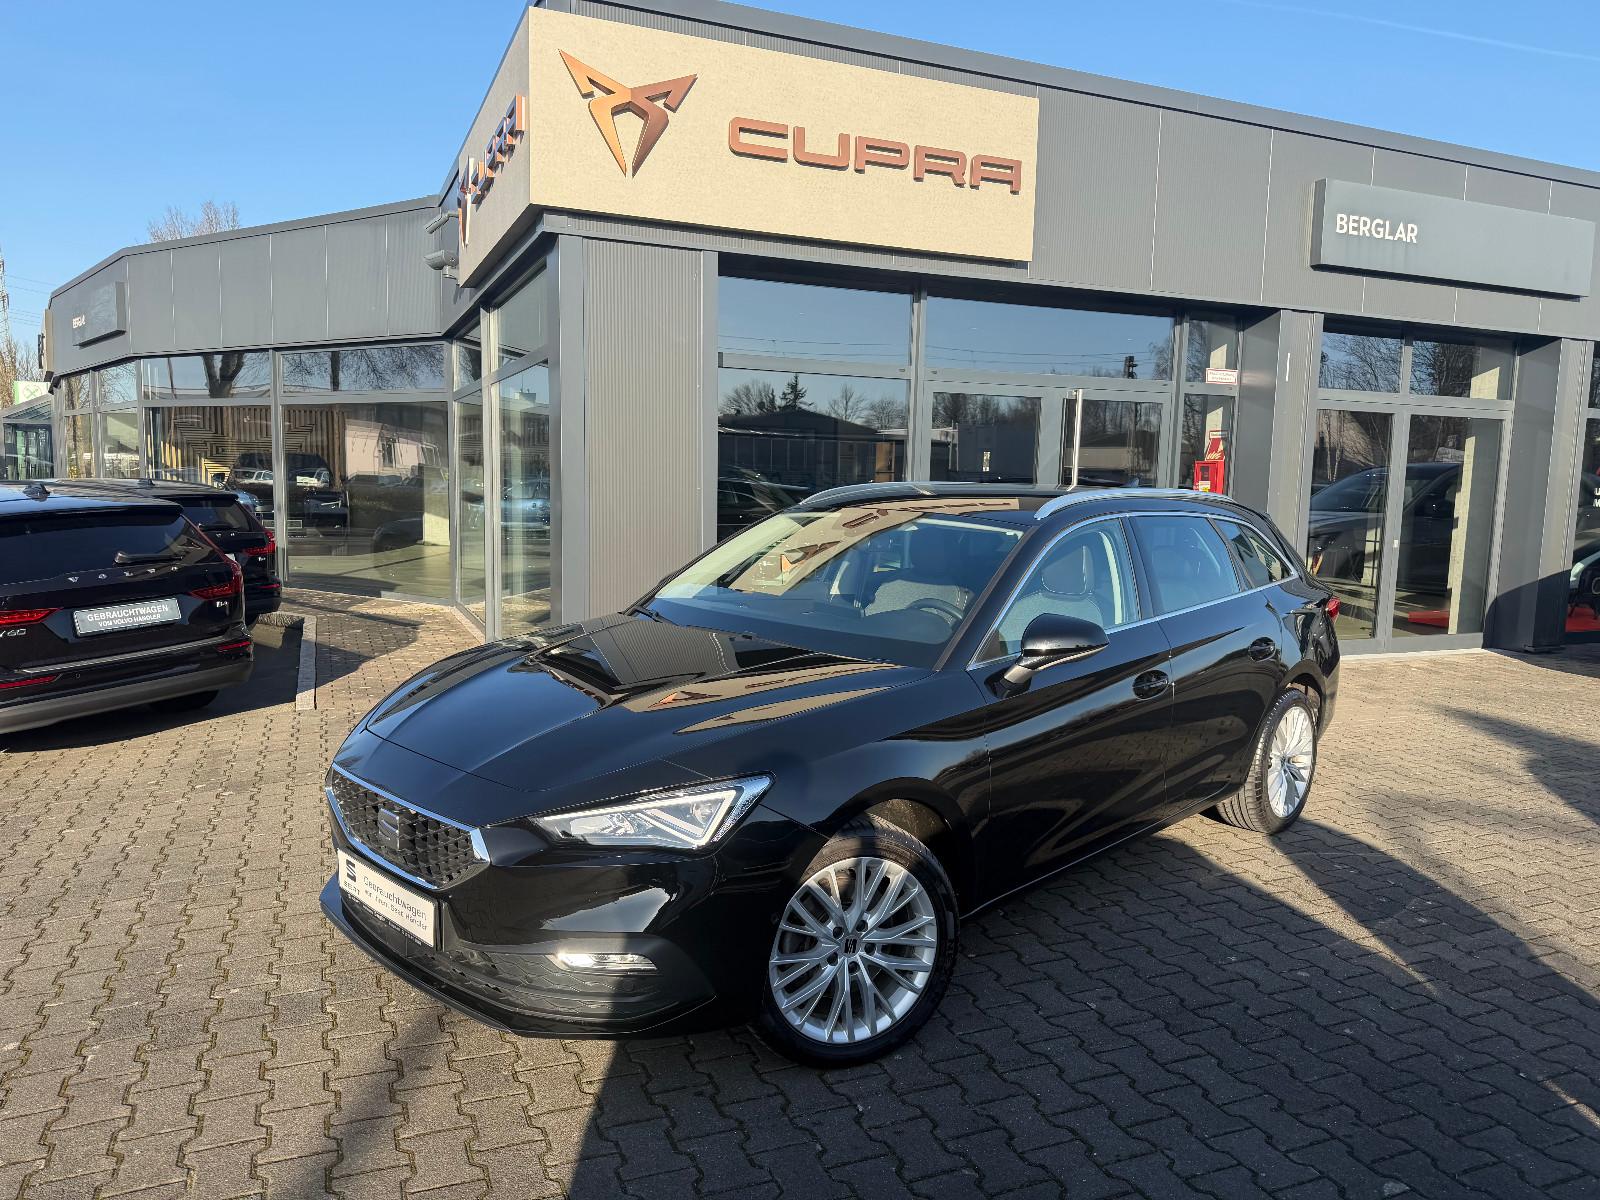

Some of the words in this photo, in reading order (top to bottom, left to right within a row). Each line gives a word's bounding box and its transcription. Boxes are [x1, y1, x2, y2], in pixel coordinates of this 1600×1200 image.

[728, 116, 1022, 195] CUPRA
[1335, 213, 1418, 244] BERGLAR
[87, 604, 169, 622] GEBRAUCHTWAGEN
[98, 619, 113, 627] VOM
[113, 617, 133, 626] VOLVO
[363, 875, 427, 921] Gebrauchtwagen
